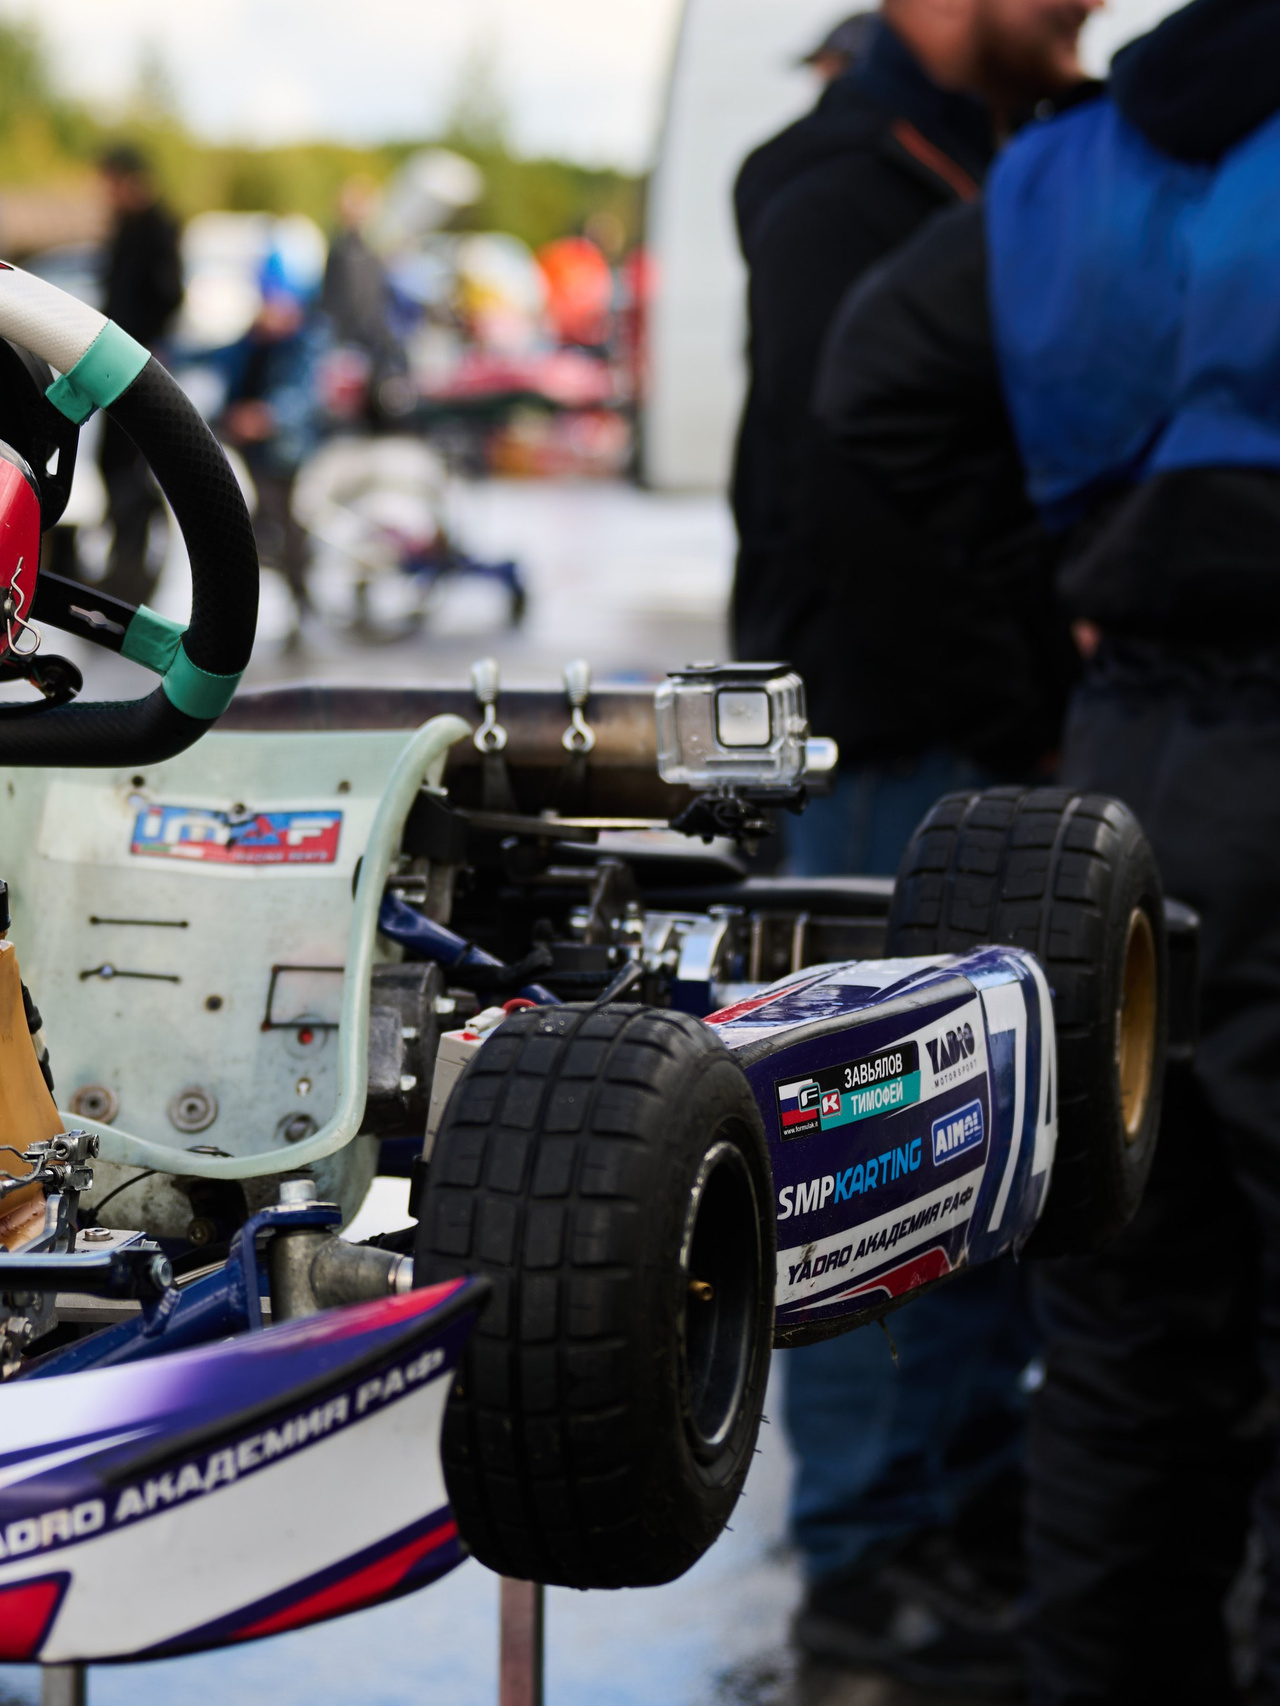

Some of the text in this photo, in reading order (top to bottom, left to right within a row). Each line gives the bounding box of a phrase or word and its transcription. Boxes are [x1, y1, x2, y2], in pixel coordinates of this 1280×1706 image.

[844, 1053, 903, 1088] ЗАВЬЯЛОВ
[934, 1059, 977, 1087] MOTORSPORT
[850, 1077, 904, 1115] ТИМОФЕЙ
[783, 1121, 819, 1135] www.formulak.it
[935, 1110, 982, 1157] AIMOL
[787, 1187, 974, 1285] YADRO АКАДЕМИЯ РАФ
[114, 1394, 349, 1524] АКАДЕМИЯ
[356, 1347, 446, 1414] РАФ
